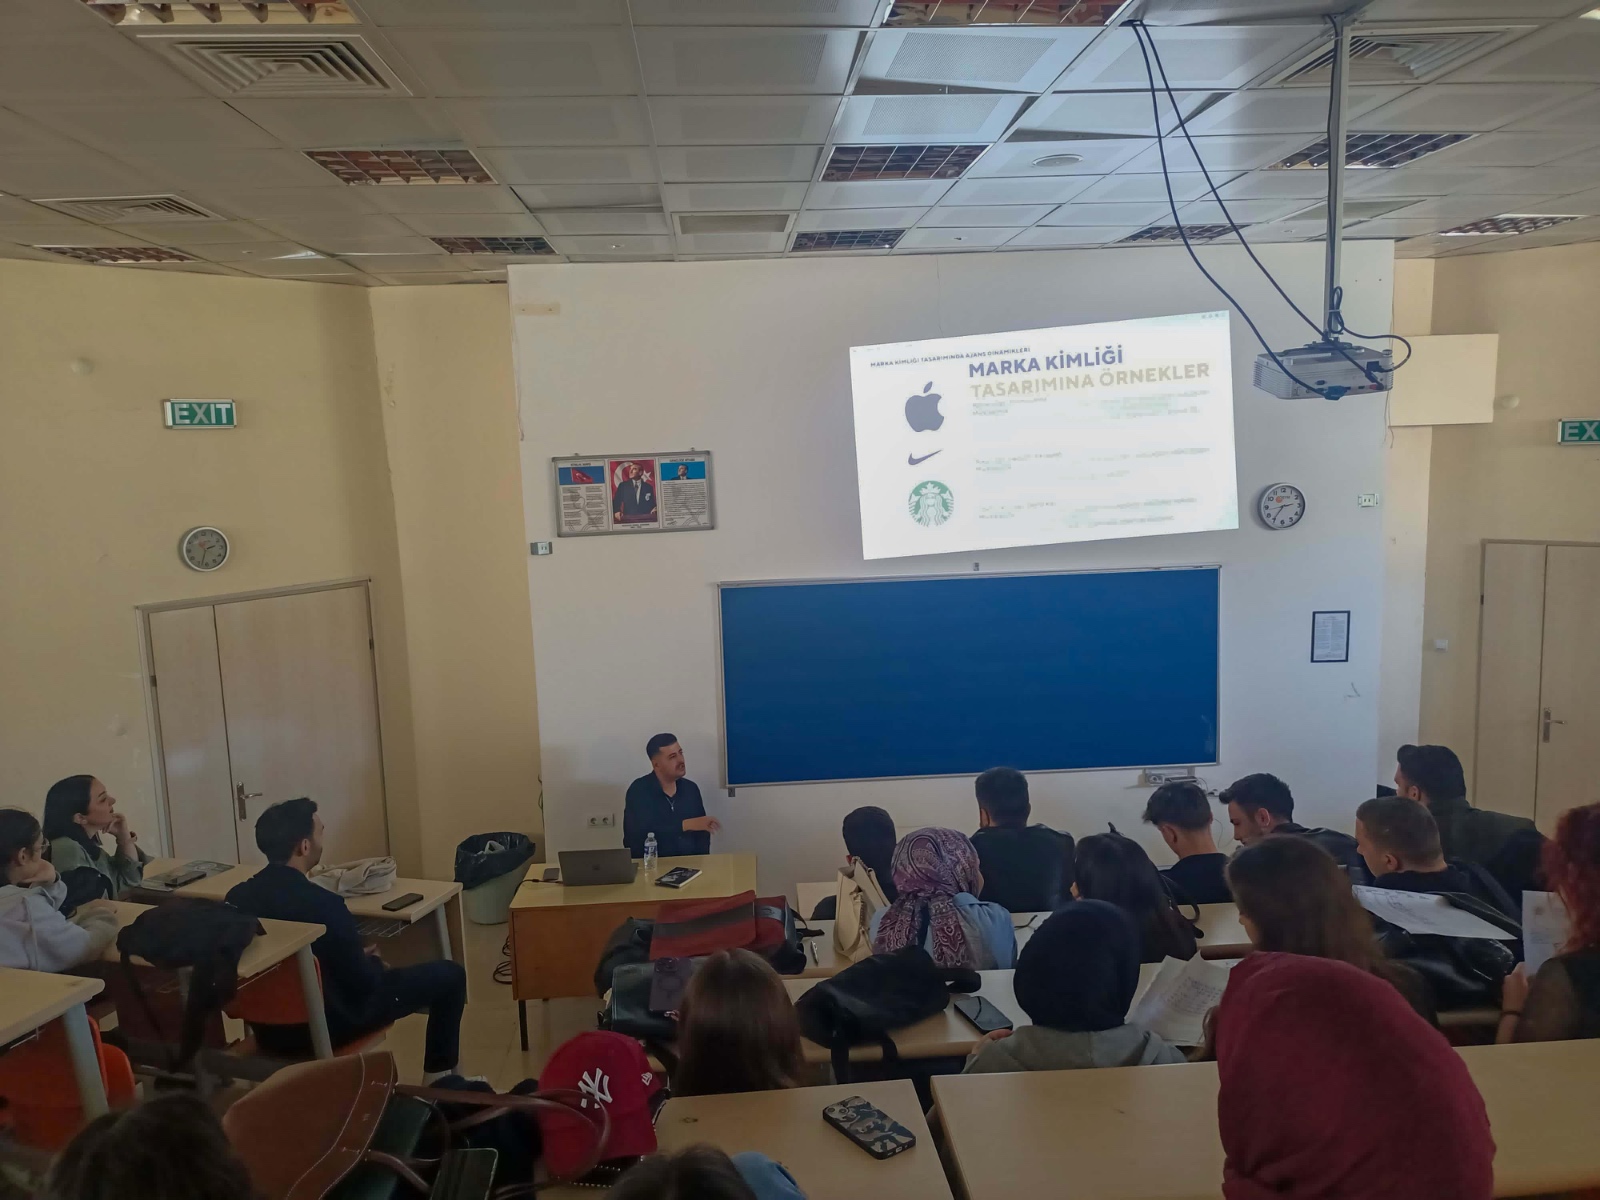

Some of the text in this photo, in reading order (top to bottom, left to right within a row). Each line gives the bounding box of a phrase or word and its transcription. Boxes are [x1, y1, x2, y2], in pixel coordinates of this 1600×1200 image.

[921, 353, 964, 363] TASARIMINDA
[965, 351, 986, 359] AJANS
[969, 344, 1124, 378] MARKA KİMLİĞİ
[970, 363, 1210, 399] TASARIMINA ÖRNEKLER
[174, 403, 231, 424] EXIT
[1564, 422, 1600, 441] EX
[577, 1067, 613, 1109] NY
